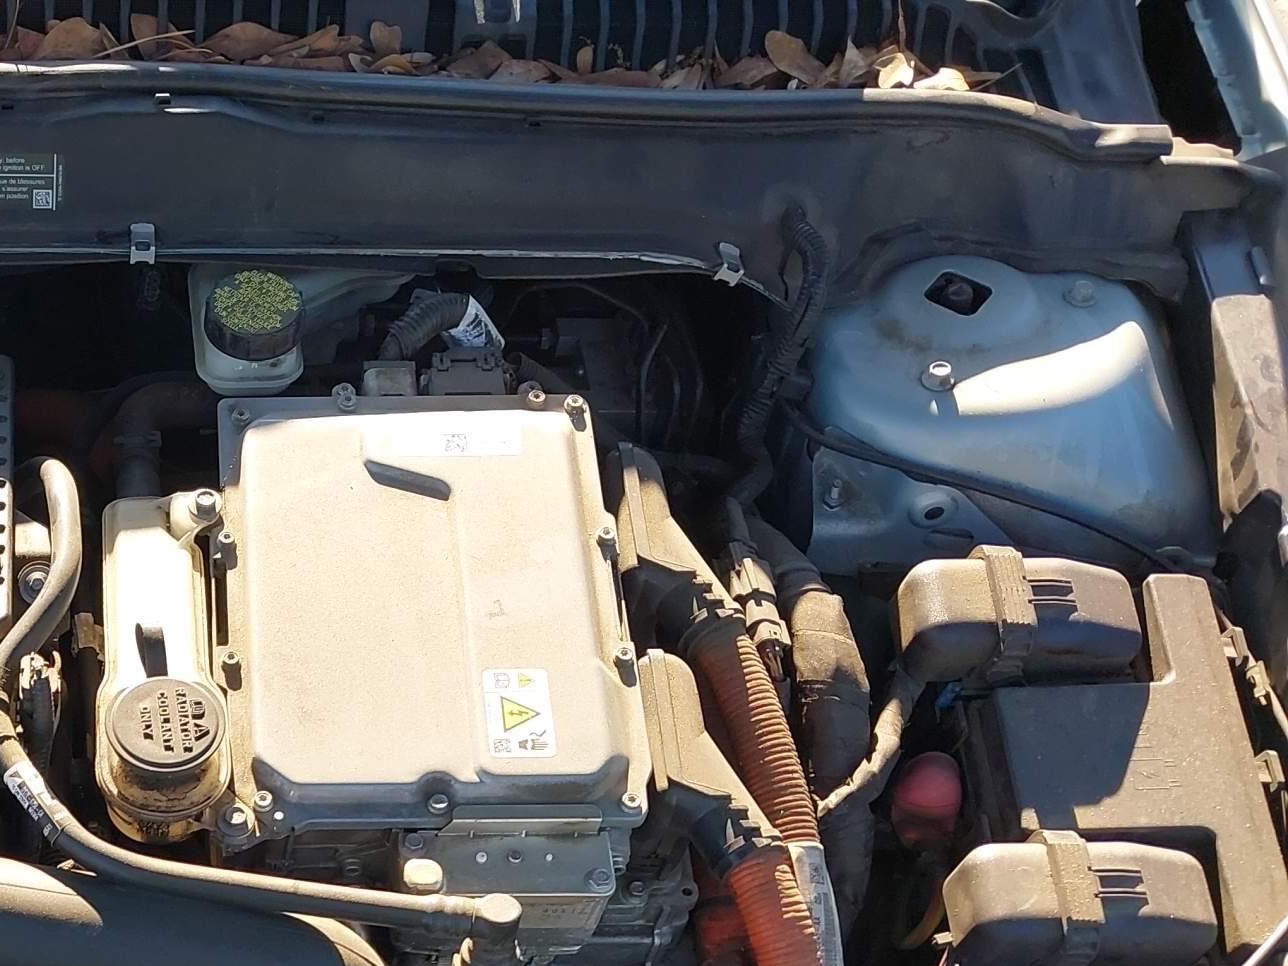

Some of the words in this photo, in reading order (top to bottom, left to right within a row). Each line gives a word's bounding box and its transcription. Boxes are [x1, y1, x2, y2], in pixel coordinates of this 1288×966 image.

[139, 704, 154, 742] ONLY
[157, 691, 174, 753] COOLANT
[175, 687, 194, 754] RADIATOR
